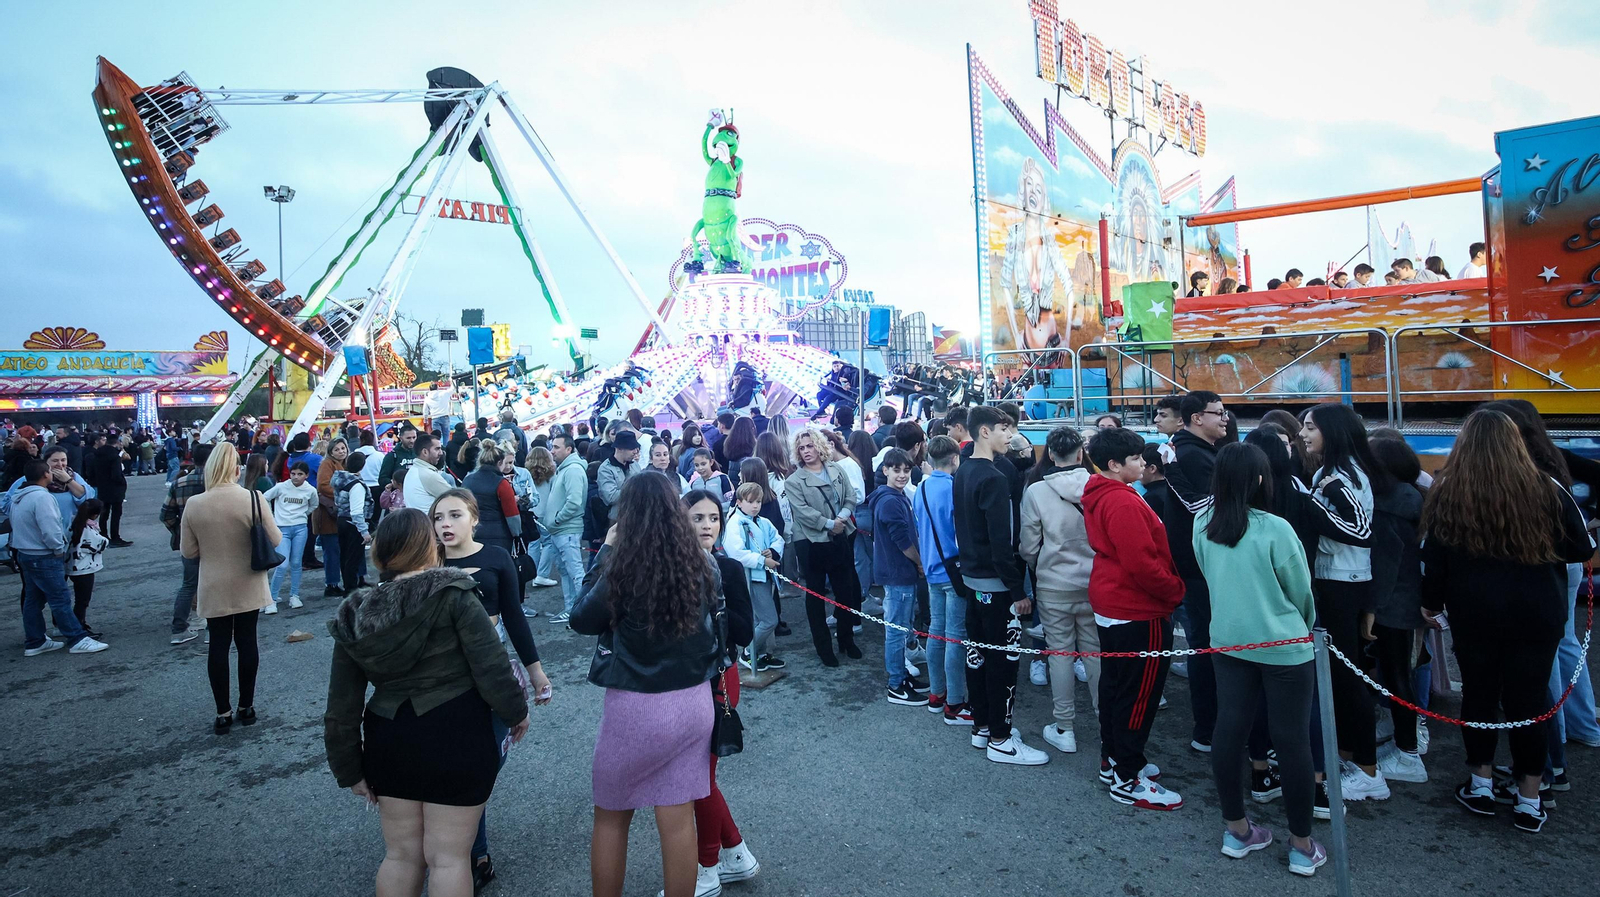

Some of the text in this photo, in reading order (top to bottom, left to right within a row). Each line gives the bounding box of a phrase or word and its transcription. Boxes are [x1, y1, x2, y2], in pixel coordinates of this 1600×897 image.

[1029, 0, 1207, 158] TORO LOCO
[741, 232, 791, 261] PER
[751, 260, 829, 297] MONTES
[0, 356, 146, 370] ATIGO ANDALUCIA
